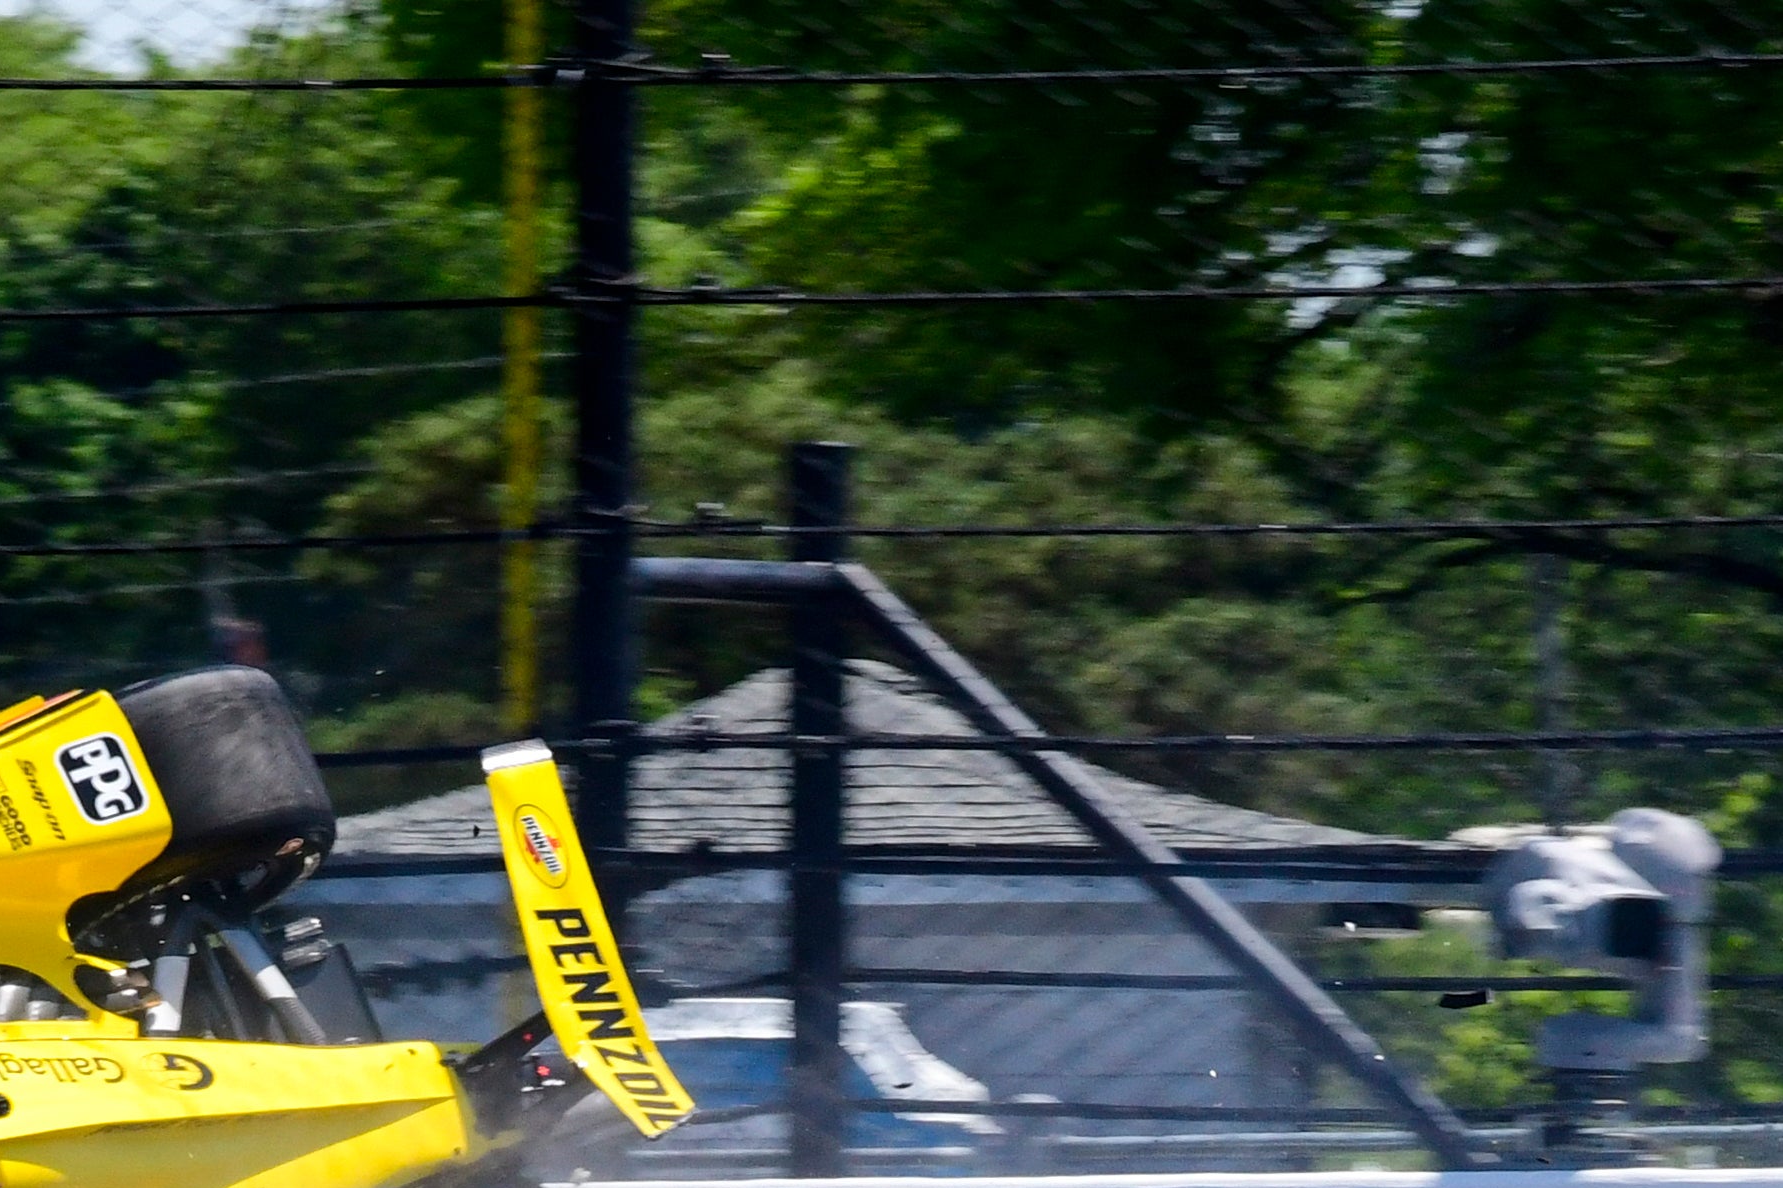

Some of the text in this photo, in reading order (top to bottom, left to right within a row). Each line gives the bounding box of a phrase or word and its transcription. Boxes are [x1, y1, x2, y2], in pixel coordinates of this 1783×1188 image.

[68, 738, 136, 819] PPG
[0, 794, 32, 846] GOOD
[519, 815, 563, 875] PENNZOIL
[533, 907, 684, 1131] PENNZOIL
